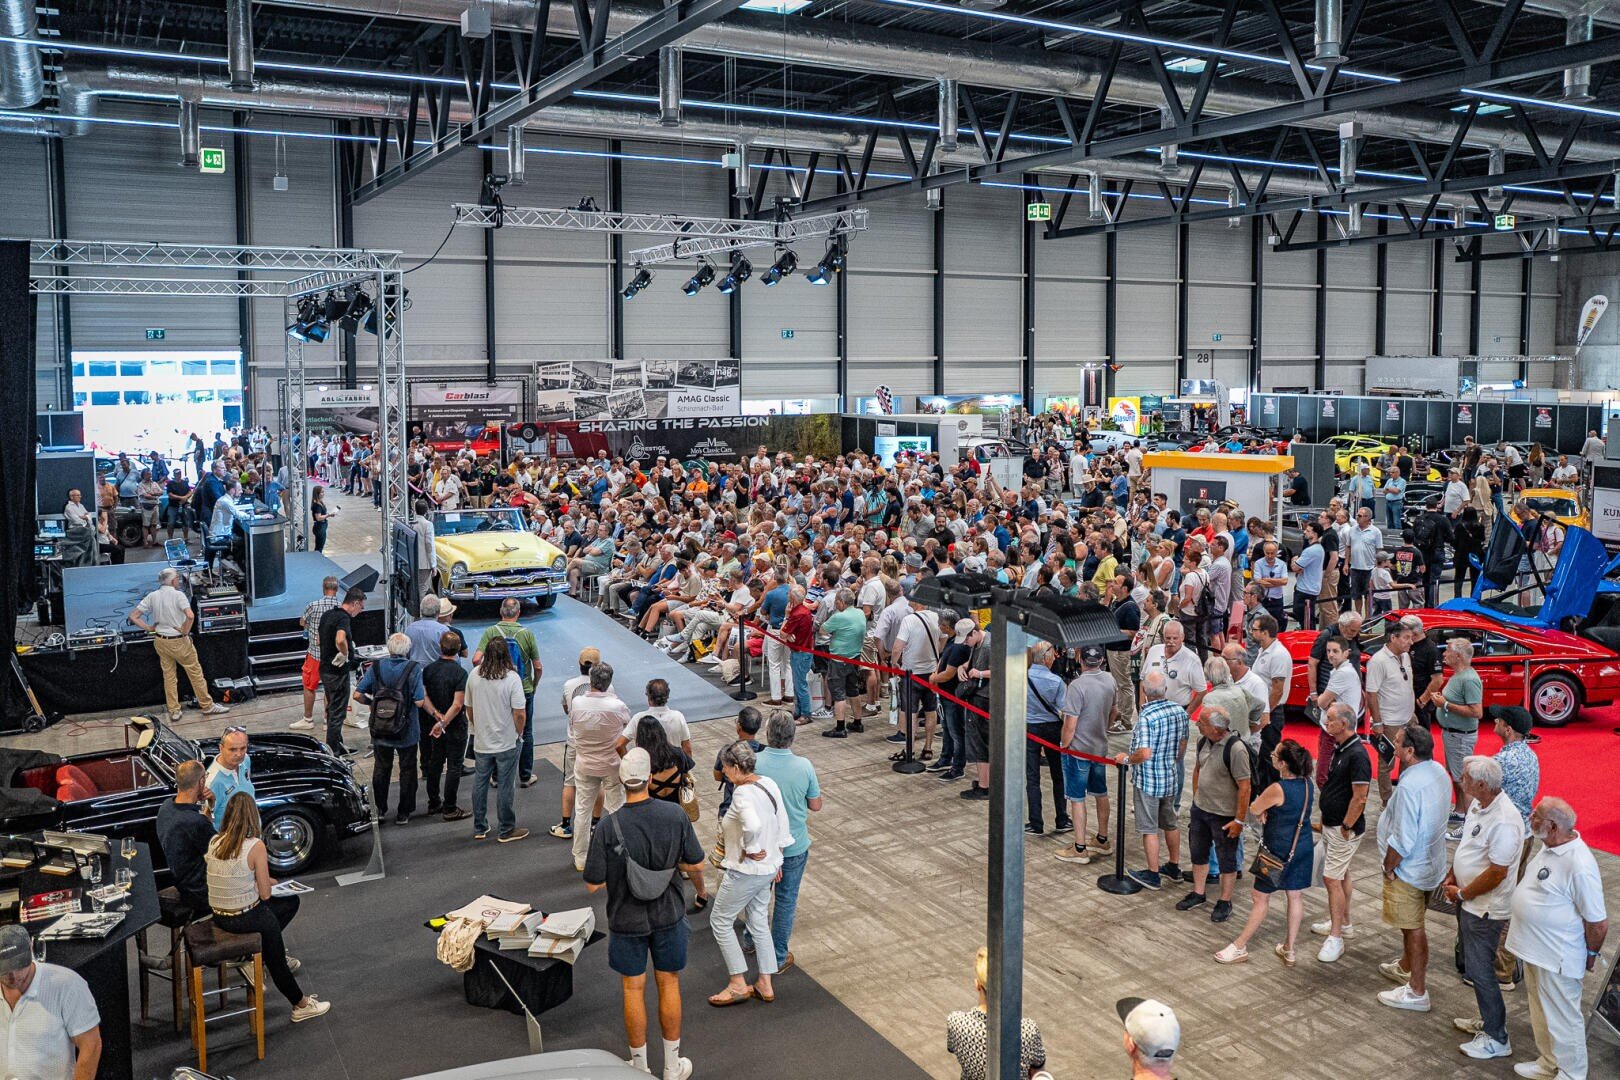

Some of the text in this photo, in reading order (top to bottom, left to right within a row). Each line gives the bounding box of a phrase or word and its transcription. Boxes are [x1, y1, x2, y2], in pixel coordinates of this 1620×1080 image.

[1197, 353, 1209, 363] 28
[709, 367, 732, 378] amag
[445, 392, 490, 400] Carblast
[677, 394, 731, 403] AMAG Classic
[578, 416, 769, 433] SHARING THE PASSION
[707, 437, 717, 447] M
